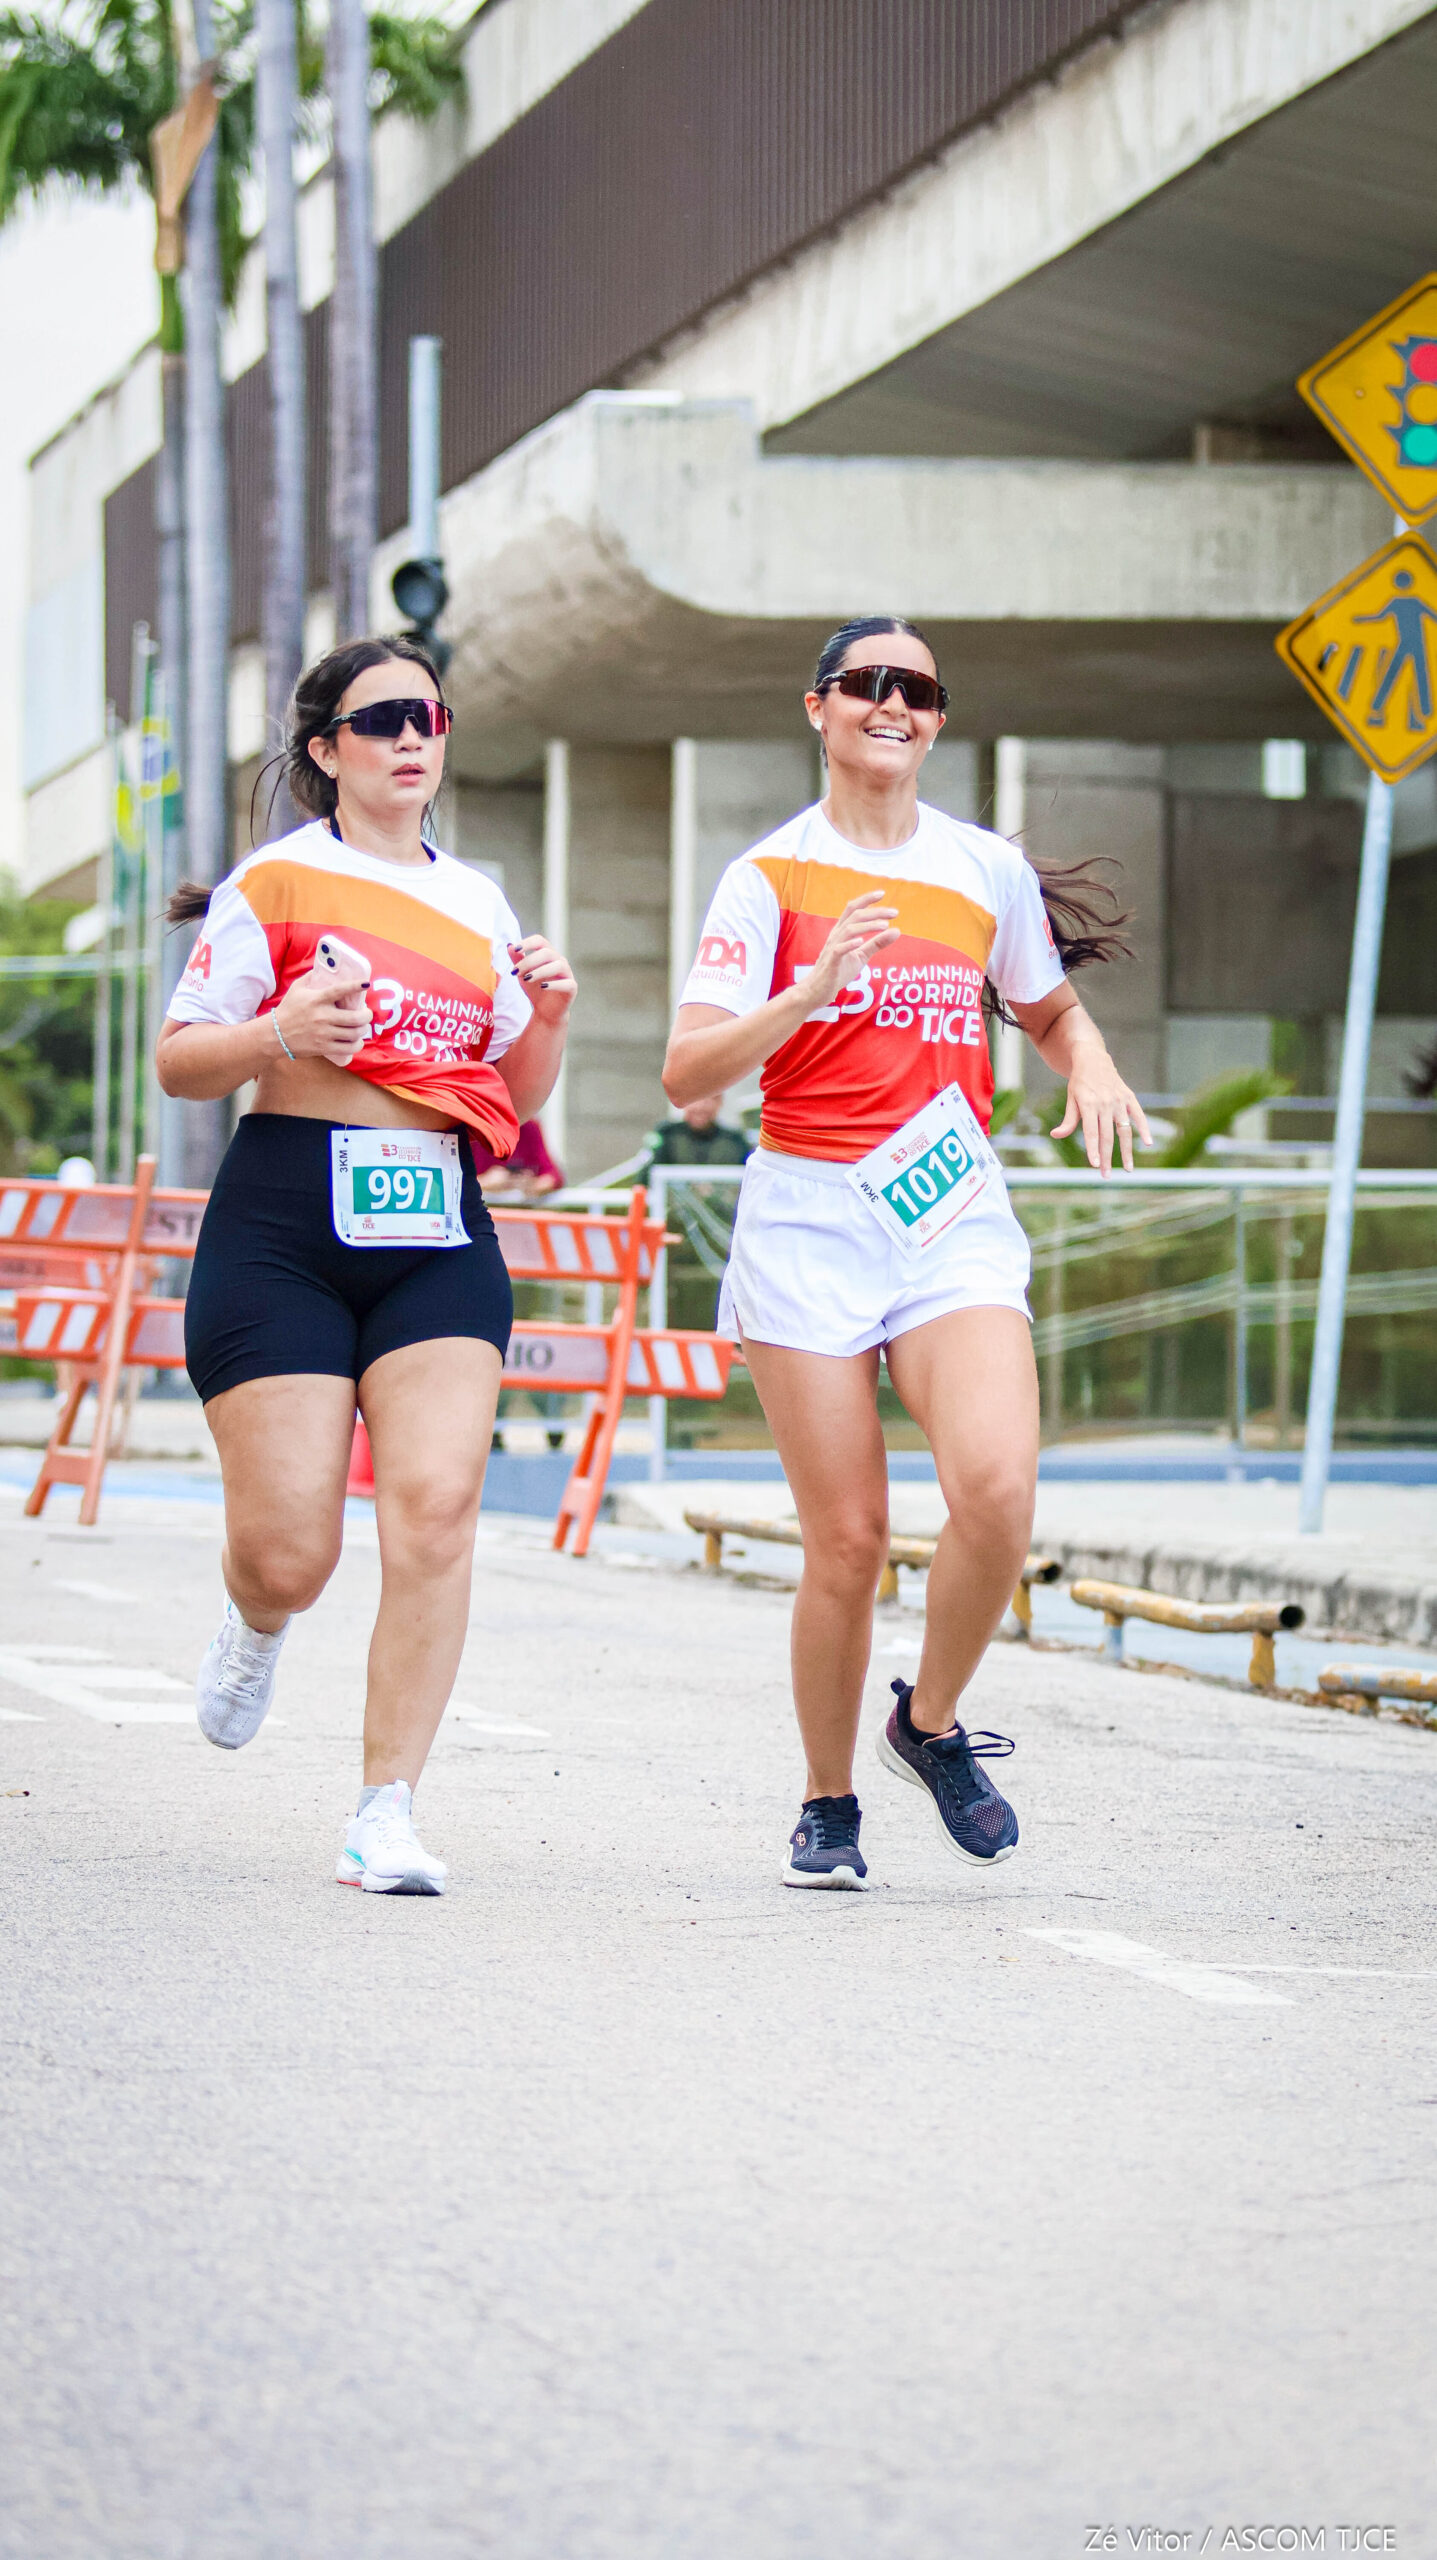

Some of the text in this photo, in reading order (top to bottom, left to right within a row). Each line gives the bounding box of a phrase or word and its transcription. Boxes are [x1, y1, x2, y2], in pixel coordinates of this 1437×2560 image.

[394, 1029, 427, 1055] DO
[875, 1005, 980, 1047] DO TJCE
[339, 1149, 348, 1173] 3KM
[891, 1135, 969, 1217] 1019
[367, 1168, 434, 1211] 997
[860, 1181, 879, 1203] 3KM
